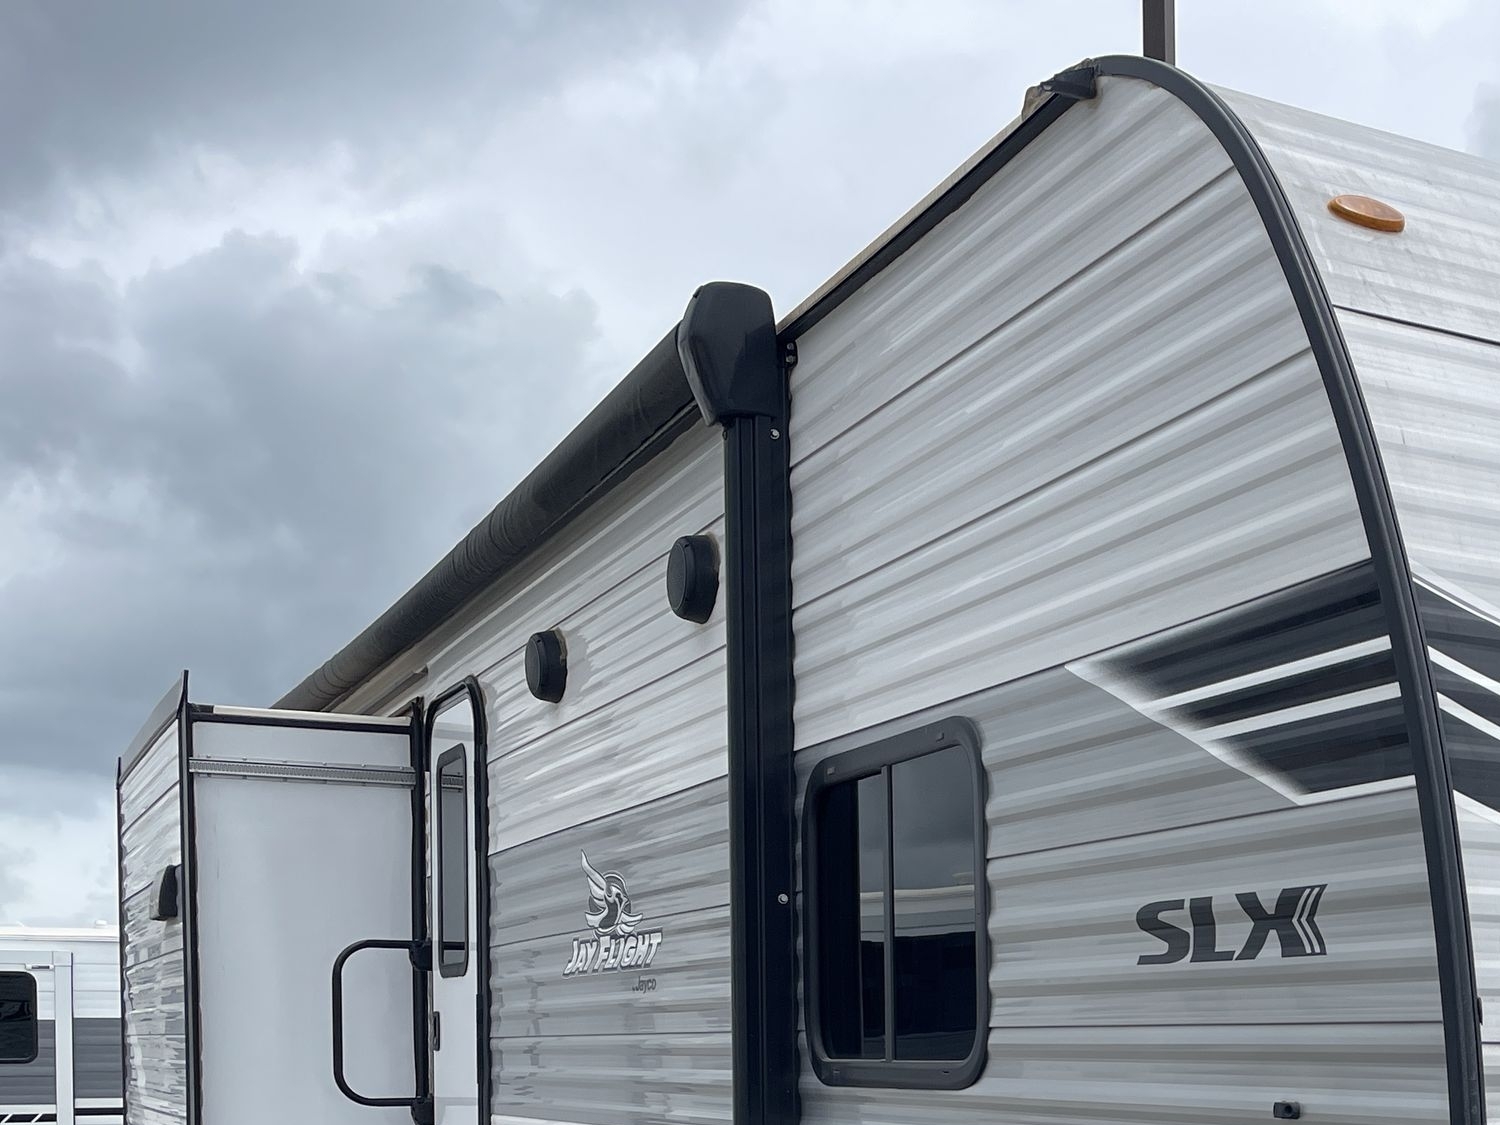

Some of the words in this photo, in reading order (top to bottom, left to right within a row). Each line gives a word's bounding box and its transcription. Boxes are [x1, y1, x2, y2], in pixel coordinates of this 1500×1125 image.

[563, 938, 599, 977] JAY
[594, 929, 663, 972] FLIGHT
[1135, 884, 1328, 965] SLX
